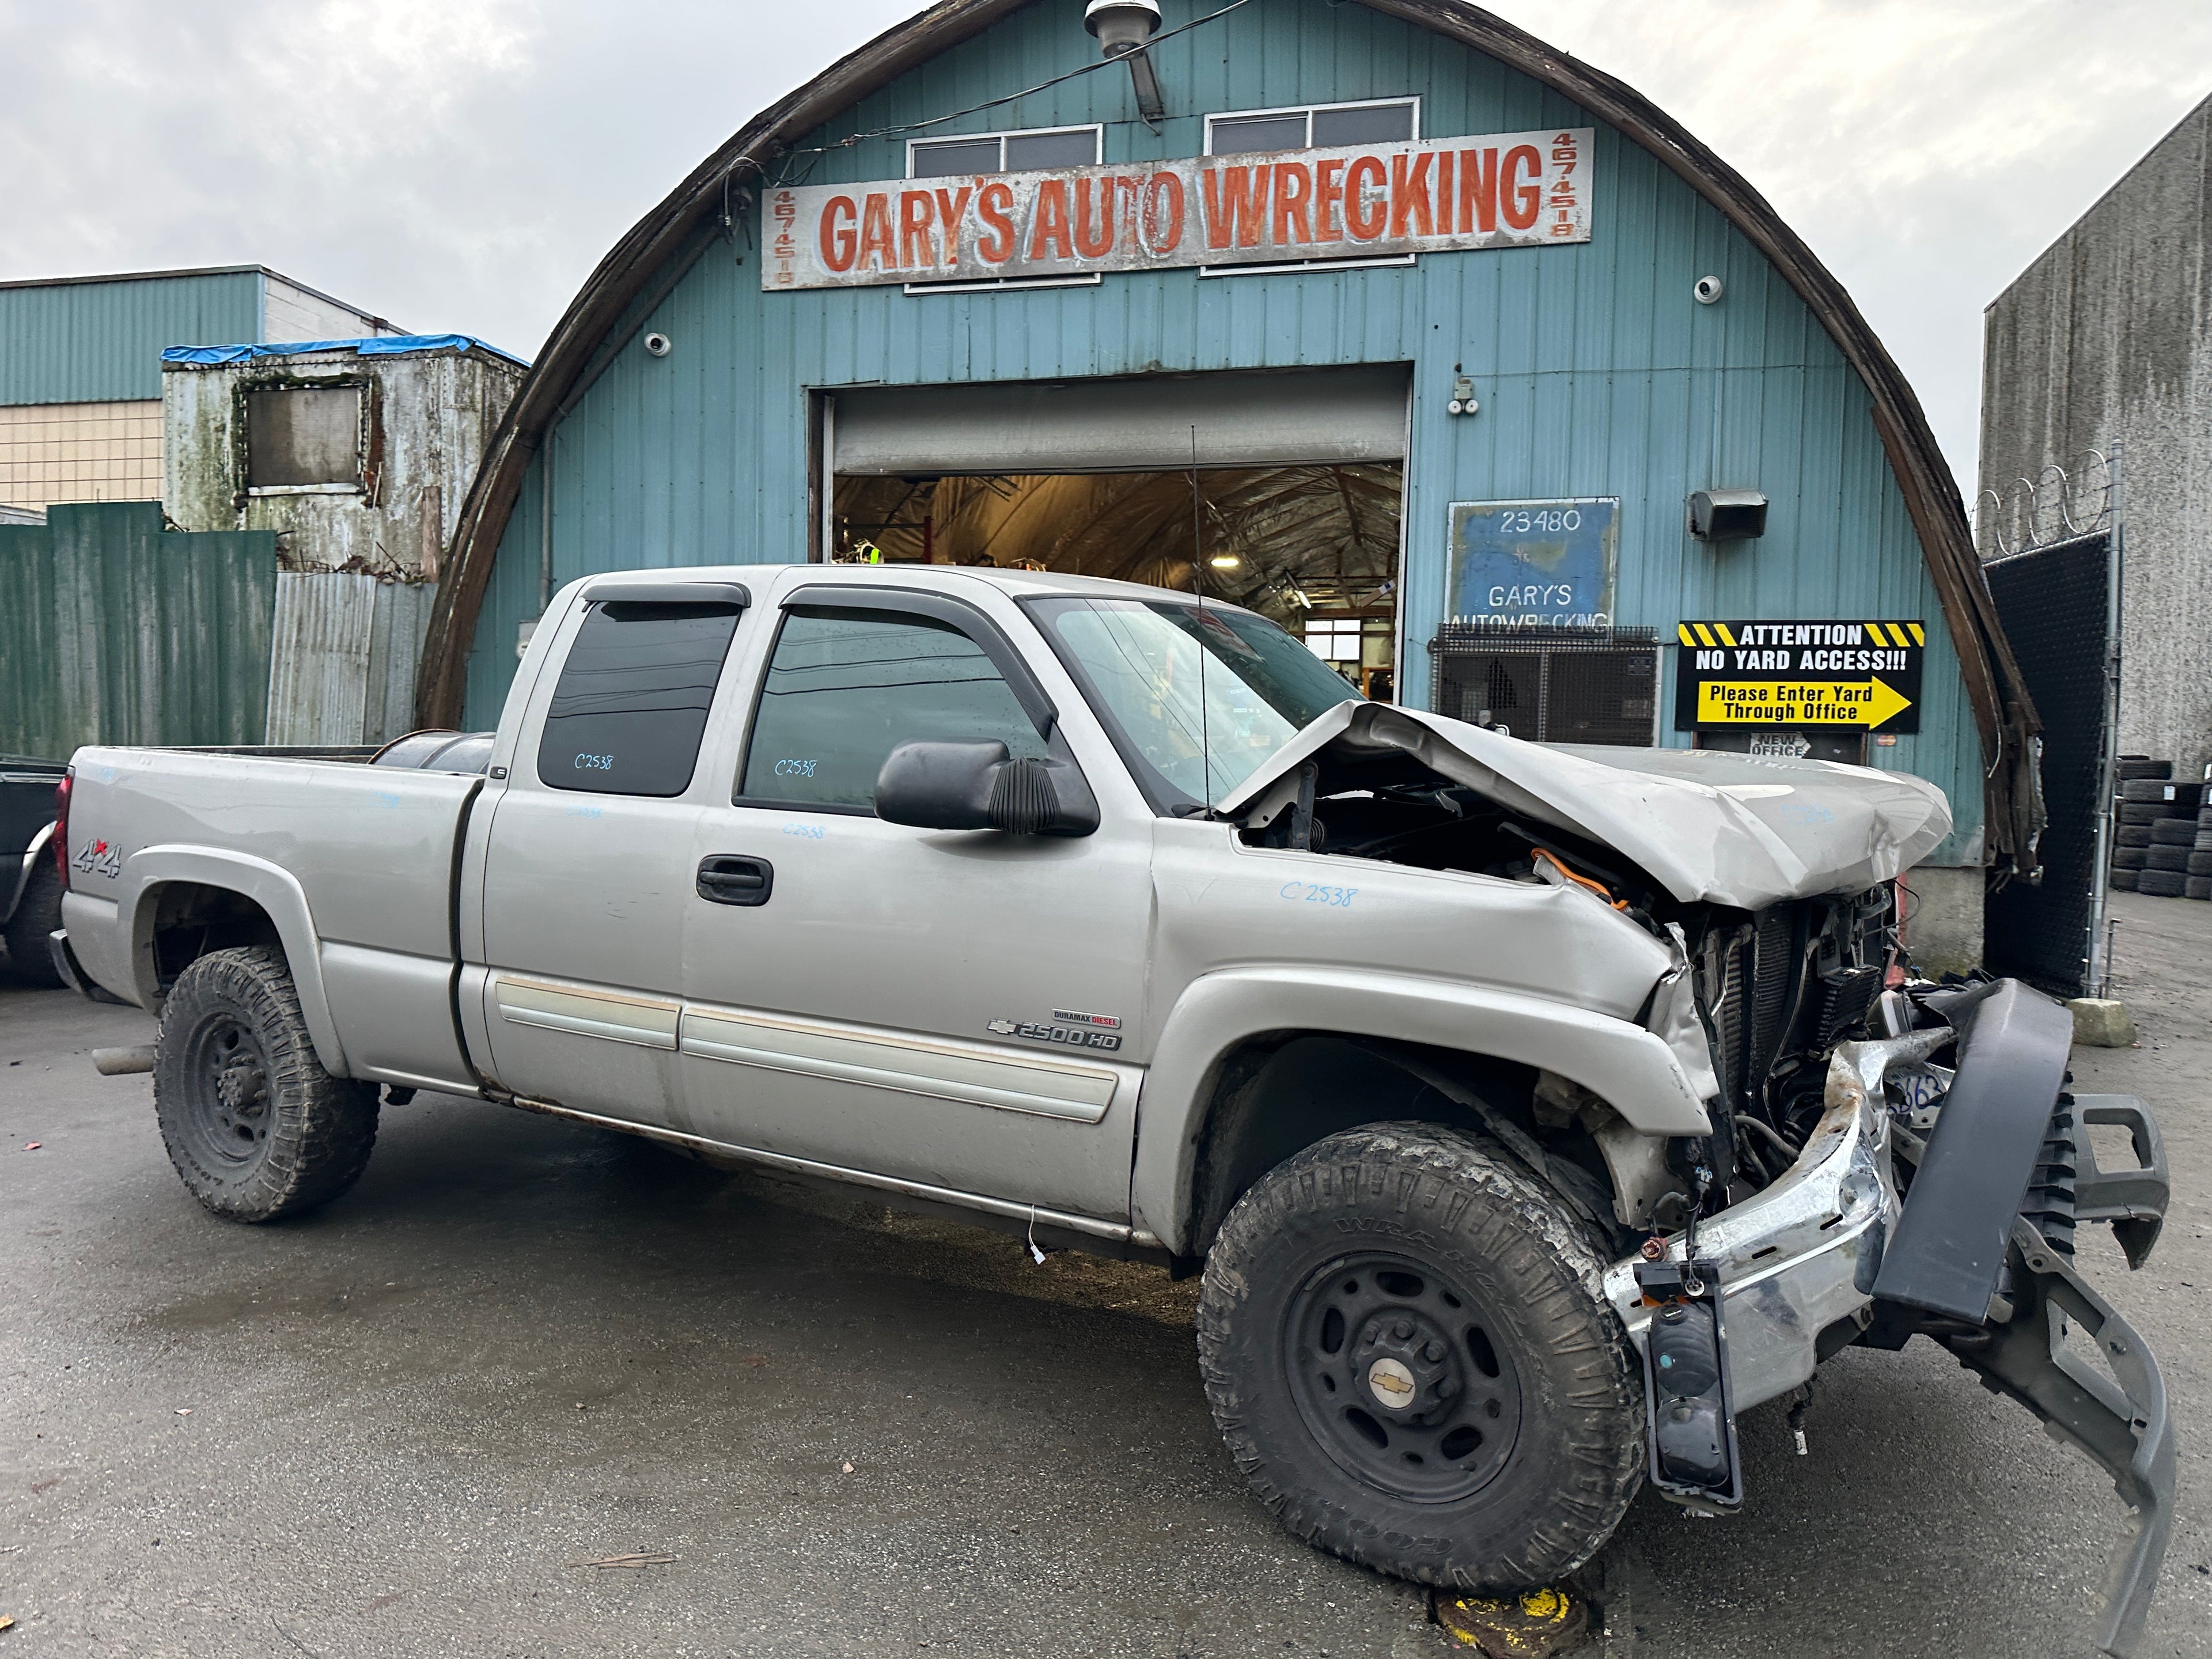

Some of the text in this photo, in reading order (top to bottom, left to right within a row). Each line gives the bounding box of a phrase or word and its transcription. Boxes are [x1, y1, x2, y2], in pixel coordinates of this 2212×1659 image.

[819, 145, 1542, 272] GARY'S AUTO WRECKING
[1500, 510, 1581, 533] 23480
[1488, 584, 1572, 607] GARY'S
[1739, 624, 1862, 646] ATTENTION
[1695, 650, 1907, 671] NO YARD ACCESS!!!
[1710, 685, 1873, 702] Please Enter Yard
[1724, 703, 1857, 721] Through Office
[1758, 734, 1796, 745] NEW
[1751, 745, 1803, 756] OFFICE
[575, 753, 615, 770] C2538
[775, 759, 818, 778] C2538
[1054, 1011, 1118, 1027] DURAMAX DIESEL
[1018, 1022, 1120, 1050] 2500 HD
